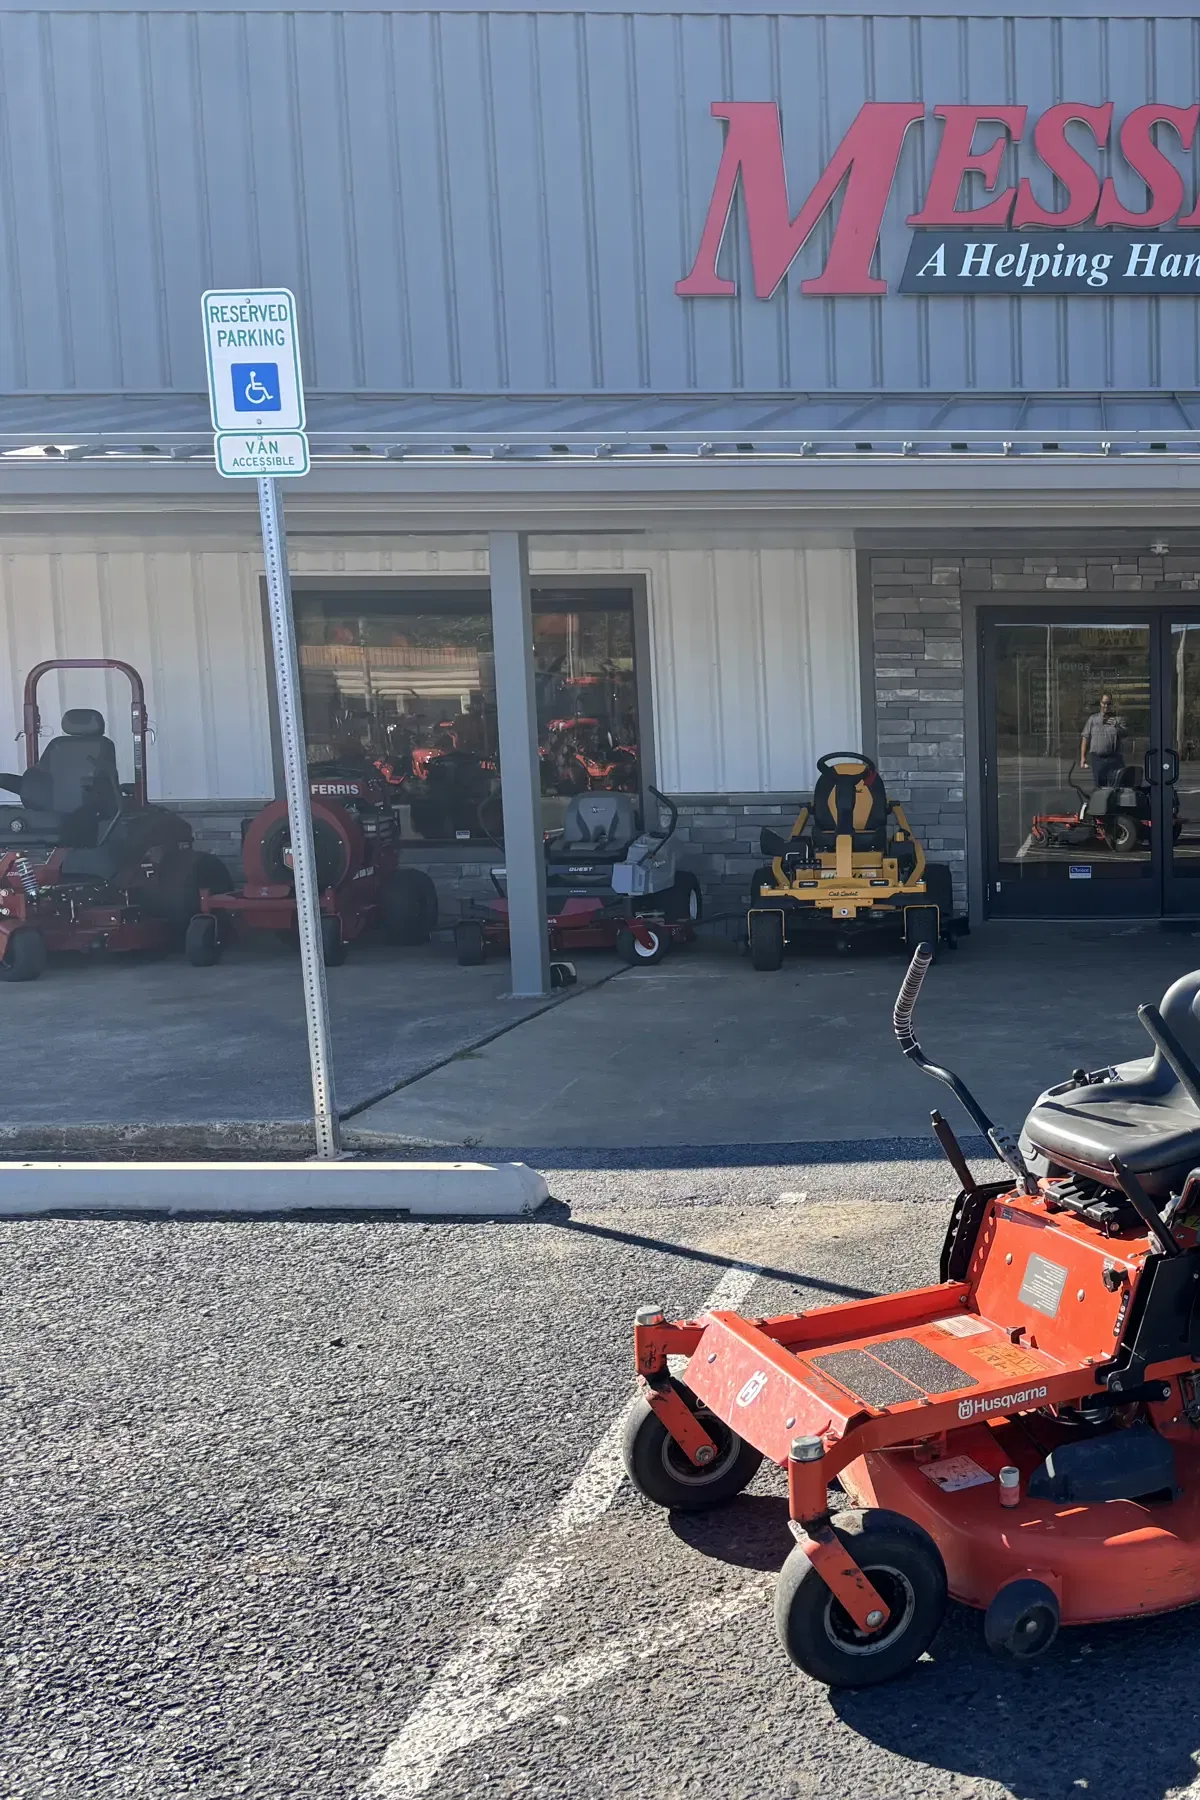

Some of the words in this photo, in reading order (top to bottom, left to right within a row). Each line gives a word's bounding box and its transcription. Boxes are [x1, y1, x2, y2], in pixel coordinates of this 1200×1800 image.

[916, 243, 946, 277] A
[957, 243, 1113, 287] Helping
[210, 304, 288, 323] RESERVED
[217, 328, 285, 347] PARKING
[245, 441, 279, 454] VAN
[232, 456, 295, 467] ACCESSIBLE
[311, 784, 359, 795] FERRIS
[974, 1385, 1047, 1413] Husqvarna
